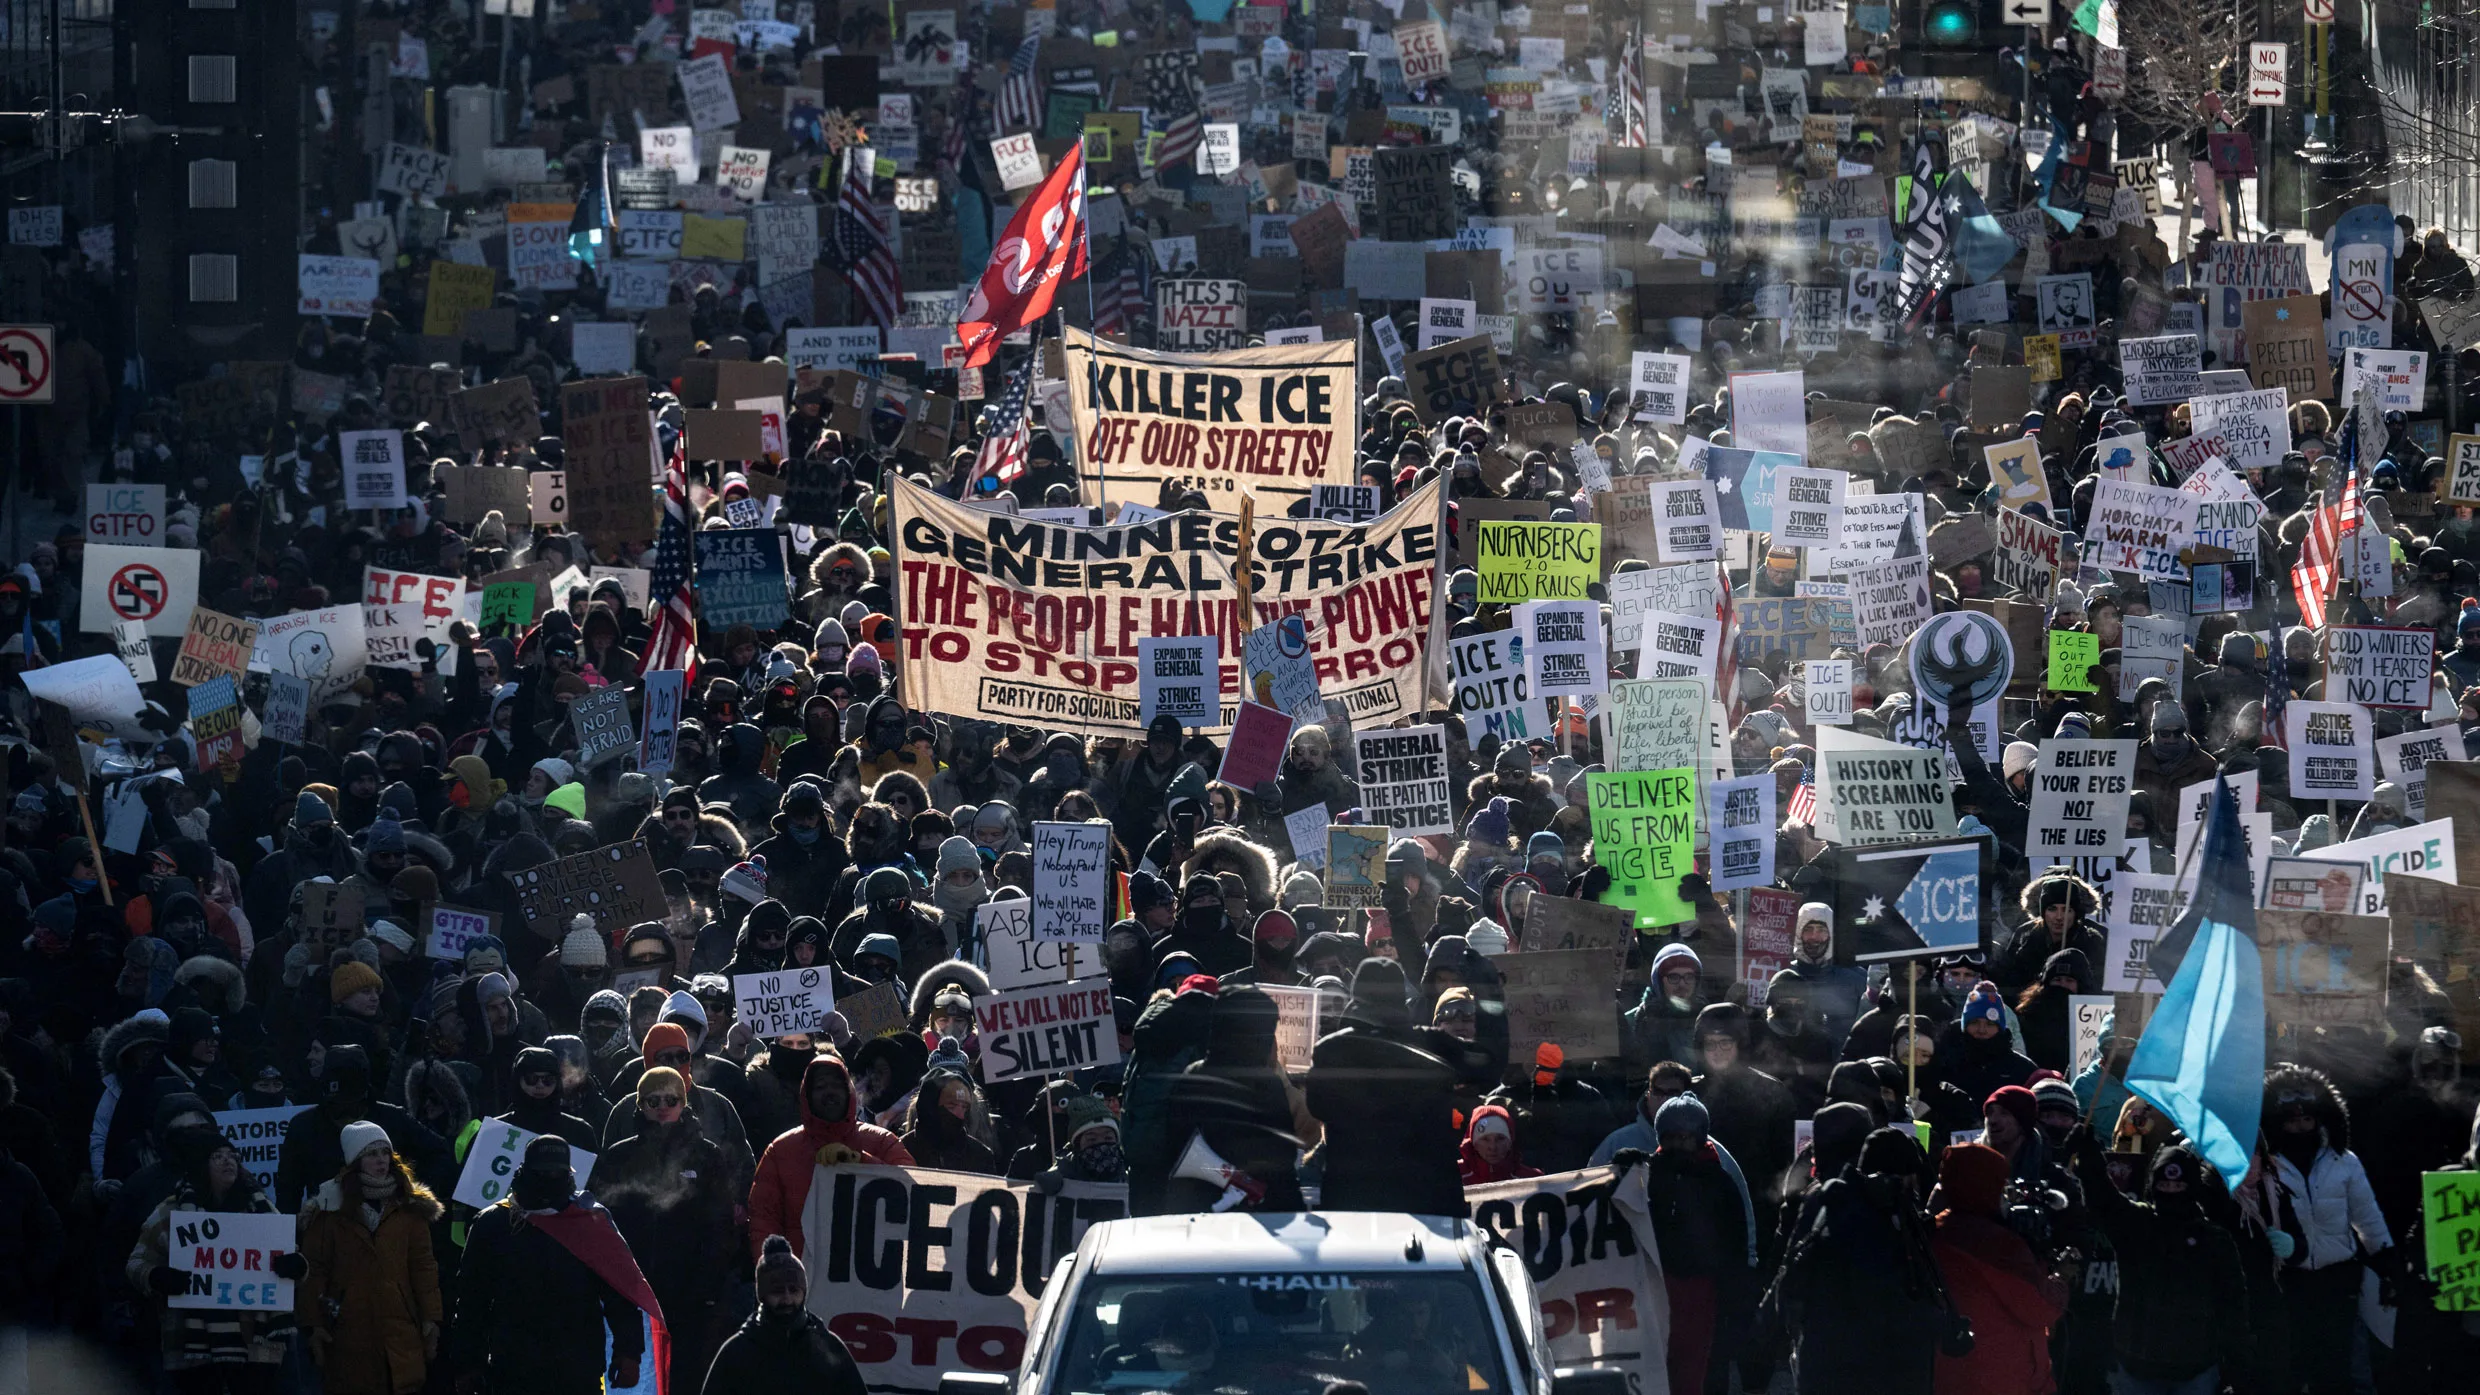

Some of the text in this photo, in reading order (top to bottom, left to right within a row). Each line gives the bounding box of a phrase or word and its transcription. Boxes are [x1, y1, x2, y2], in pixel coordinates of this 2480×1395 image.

[1400, 35, 1437, 58] ICE
[1405, 53, 1443, 76] OUT!
[2259, 51, 2277, 64] NO
[2252, 69, 2284, 83] STOPPING
[733, 151, 757, 164] NO
[996, 142, 1030, 160] FUCK
[2115, 161, 2157, 188] FUCK
[897, 179, 933, 195] ICE
[636, 213, 668, 225] ICE
[1533, 253, 1580, 272] ICE
[2211, 244, 2301, 264] MAKE AMERICA
[2216, 262, 2258, 285] GREAT
[2349, 259, 2376, 276] MN
[1160, 281, 1216, 305] THIS
[2356, 285, 2373, 294] FUCK
[1163, 305, 1235, 328] NAZI
[2350, 304, 2360, 312] ICE
[837, 335, 877, 347] THEN
[2121, 340, 2181, 358] INJUSTICE
[2257, 340, 2314, 363] PRETTI
[1416, 347, 1490, 392] ICE
[2141, 357, 2197, 371] ANYWHERE
[2262, 368, 2314, 393] GOOD
[1088, 363, 1331, 423] KILLER ICE
[1430, 380, 1500, 413] OUT
[2193, 397, 2283, 416] IMMIGRANTS
[2220, 415, 2255, 429] MAKE
[1089, 419, 1332, 480] OFF OUR STREETS!
[1790, 477, 1833, 489] EXPAND THE
[107, 490, 145, 512] ICE
[1320, 487, 1372, 508] KILLER
[1789, 488, 1831, 504] GENERAL
[2113, 491, 2153, 505] DRINK
[2166, 498, 2187, 509] MY
[90, 514, 154, 536] GTFO
[1789, 512, 1828, 526] STRIKE!
[2101, 508, 2182, 533] HORCHATA
[988, 516, 1366, 562] MINNESOTA
[2001, 511, 2060, 567] SHAME
[2107, 525, 2167, 549] WARM
[903, 517, 1436, 593] GENERAL STRIKE
[1524, 559, 1547, 572] 2.0
[2020, 552, 2037, 564] ON
[2082, 543, 2183, 575] FUCK ICE
[1884, 569, 1893, 581] IS
[1898, 562, 1923, 579] WHAT
[487, 587, 521, 599] FUCK
[1480, 572, 1591, 598] NAZIS RAUS!
[1858, 585, 1908, 605] IT SOUNDS
[483, 604, 517, 619] ICE
[902, 561, 1142, 656] THE PEOPLE
[1868, 605, 1916, 622] LIKE WHEN
[193, 614, 255, 648] NO ONE
[1866, 625, 1902, 643] DOVES
[2056, 635, 2088, 648] ICE
[184, 633, 241, 670] ILLEGAL
[2329, 632, 2430, 654] COLD WINTERS
[903, 628, 1137, 691] TO STOP
[1153, 649, 1202, 660] EXPAND THE
[1455, 640, 1501, 677] ICE
[2060, 652, 2085, 661] OUT
[1154, 660, 1203, 677] GENERAL
[1813, 665, 1843, 684] ICE
[2065, 663, 2082, 673] OF
[2329, 657, 2429, 678] WARM HEARTS
[576, 690, 620, 714] WE ARE
[1159, 689, 1202, 703] STRIKE!
[1461, 680, 1513, 710] OUT
[2349, 680, 2416, 703] NO ICE
[1811, 692, 1851, 714] OUT!!
[193, 707, 239, 736] ICE OUT
[583, 708, 619, 734] NOT
[1485, 707, 1527, 738] MN
[2307, 714, 2351, 729] JUSTICE
[583, 724, 632, 754] AFRAID
[1360, 734, 1443, 760] GENERAL
[2306, 729, 2354, 746] FOR ALEX
[1362, 757, 1445, 783] STRIKE:
[1838, 759, 1941, 780] HISTORY IS
[2056, 751, 2116, 768] BELIEVE
[2306, 758, 2357, 768] JEFFREY PRETTI
[2041, 775, 2125, 794] YOUR EYES
[2306, 769, 2357, 779] KILLED BY CBP
[1363, 783, 1447, 803] THE PATH TO
[1596, 778, 1688, 808] DELIVER
[1838, 784, 1943, 805] SCREAMING
[1370, 805, 1450, 828] JUSTICE
[1851, 809, 1934, 830] ARE YOU
[2065, 801, 2093, 818] NOT
[1599, 813, 1690, 844] US FROM
[2041, 829, 2106, 846] THE LIES
[1036, 829, 1105, 863] Hey Trump
[1609, 846, 1675, 880] ICE
[1060, 874, 1079, 888] US
[1036, 893, 1054, 909] We
[1921, 876, 1978, 925] ICE
[1055, 910, 1081, 926] YOU
[1072, 923, 1100, 936] FREE
[760, 976, 780, 995] NO
[743, 992, 813, 1016] JUSTICE
[977, 987, 1111, 1030] WE WILL NOT BE
[771, 1010, 822, 1033] PEACE
[994, 1023, 1101, 1077] SILENT
[176, 1218, 220, 1247] NO
[829, 1175, 956, 1292] ICE
[217, 1283, 276, 1305] ICE
